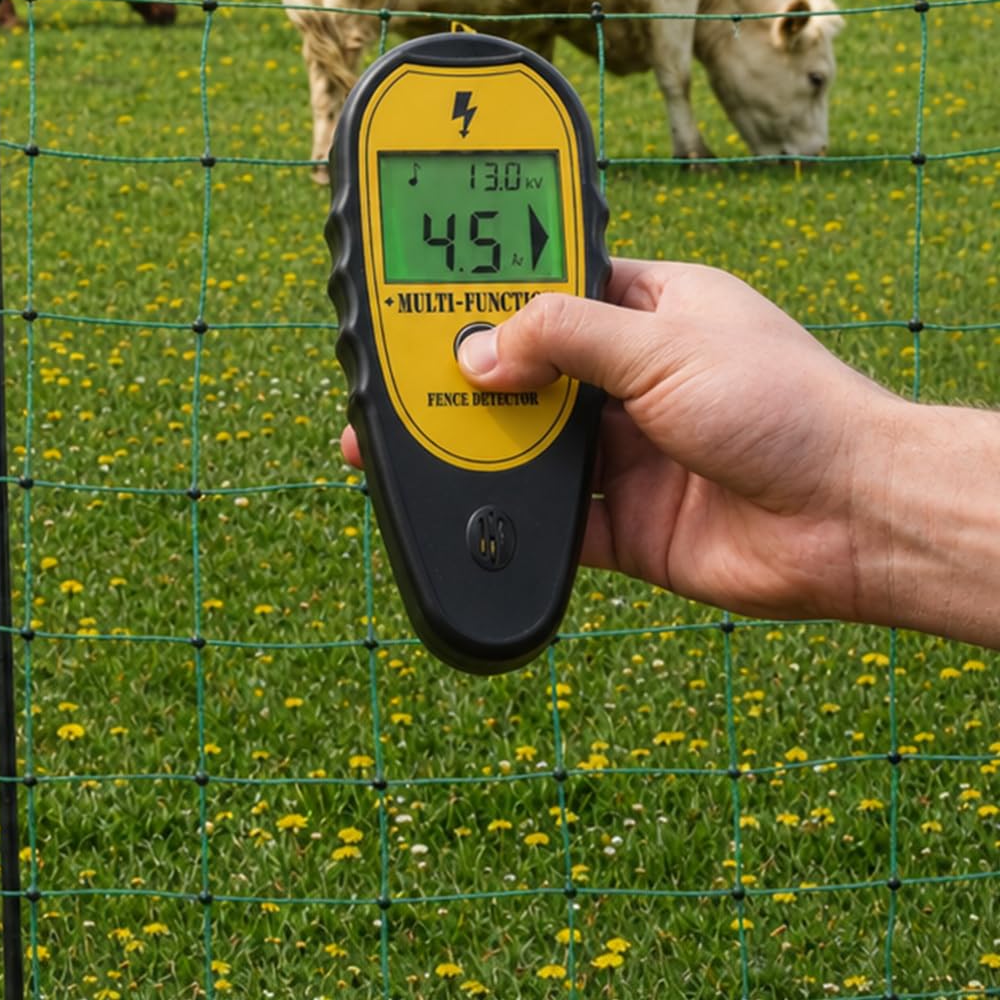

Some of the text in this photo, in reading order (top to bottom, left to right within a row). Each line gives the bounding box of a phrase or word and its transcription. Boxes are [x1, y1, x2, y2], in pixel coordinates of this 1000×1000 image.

[470, 162, 521, 192] 13.0
[423, 211, 501, 274] 4.5
[397, 291, 541, 313] MULTI-FUNCTI
[427, 391, 539, 407] FENCE DETECTOR
